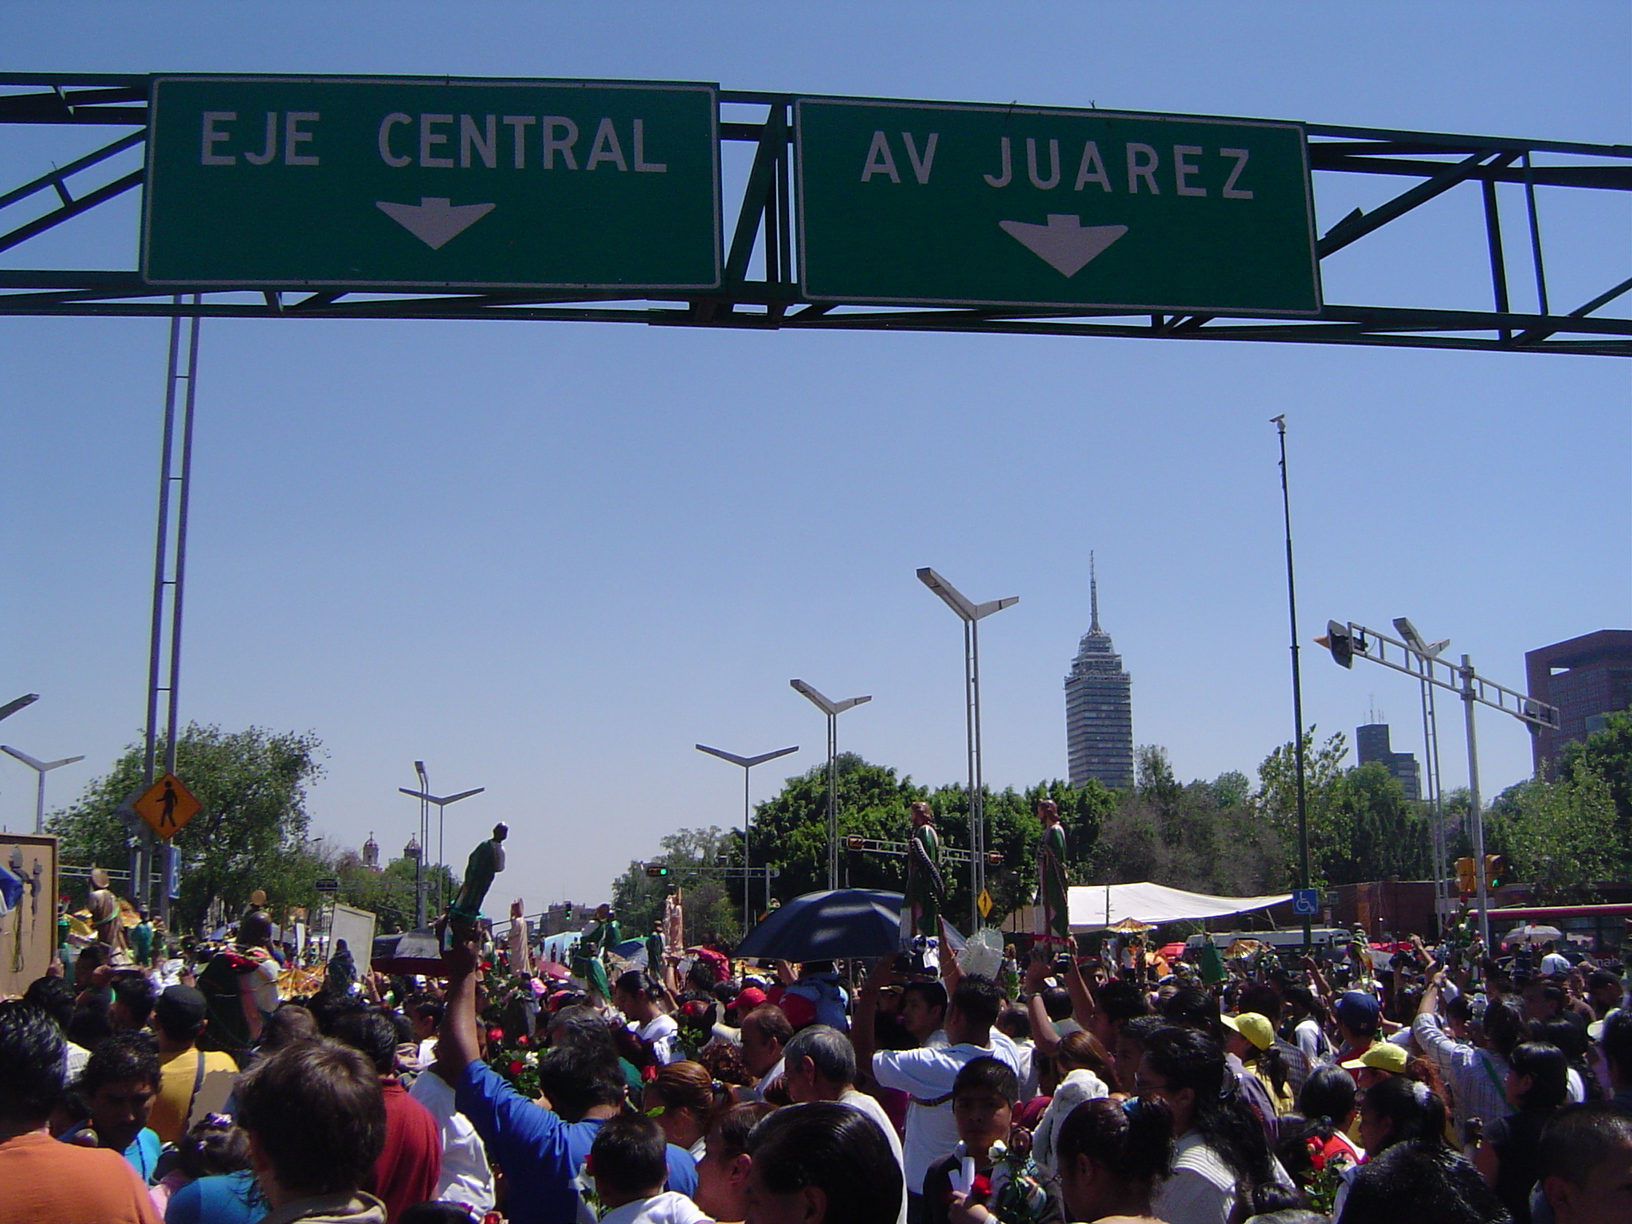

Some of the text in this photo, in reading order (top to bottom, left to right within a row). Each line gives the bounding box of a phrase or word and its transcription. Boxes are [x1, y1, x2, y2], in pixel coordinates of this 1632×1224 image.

[202, 111, 667, 173] EJE CENTRAL
[860, 131, 1253, 199] AV JUAREZ
